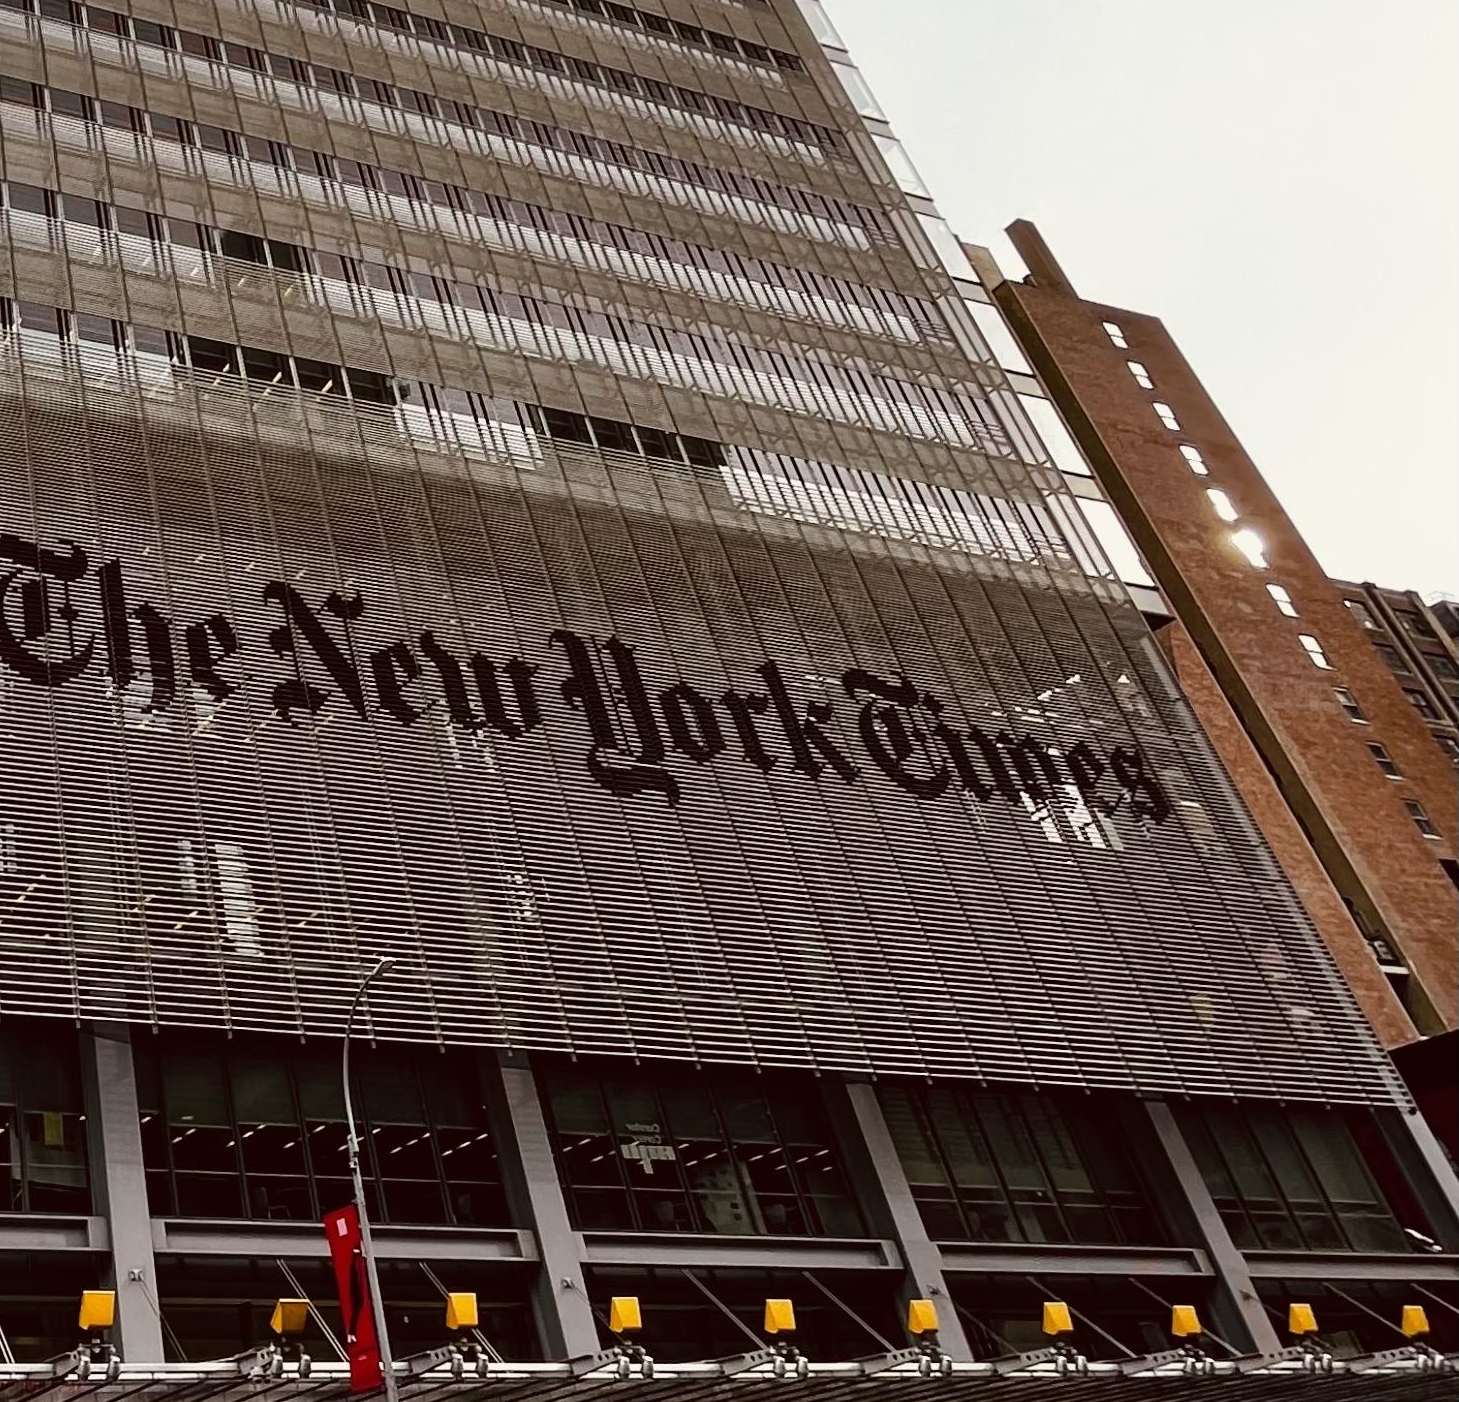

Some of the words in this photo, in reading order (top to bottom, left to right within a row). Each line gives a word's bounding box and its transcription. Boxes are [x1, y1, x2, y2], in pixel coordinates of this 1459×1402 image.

[263, 581, 536, 739] New
[550, 629, 858, 807] York
[842, 668, 1169, 824] Times
